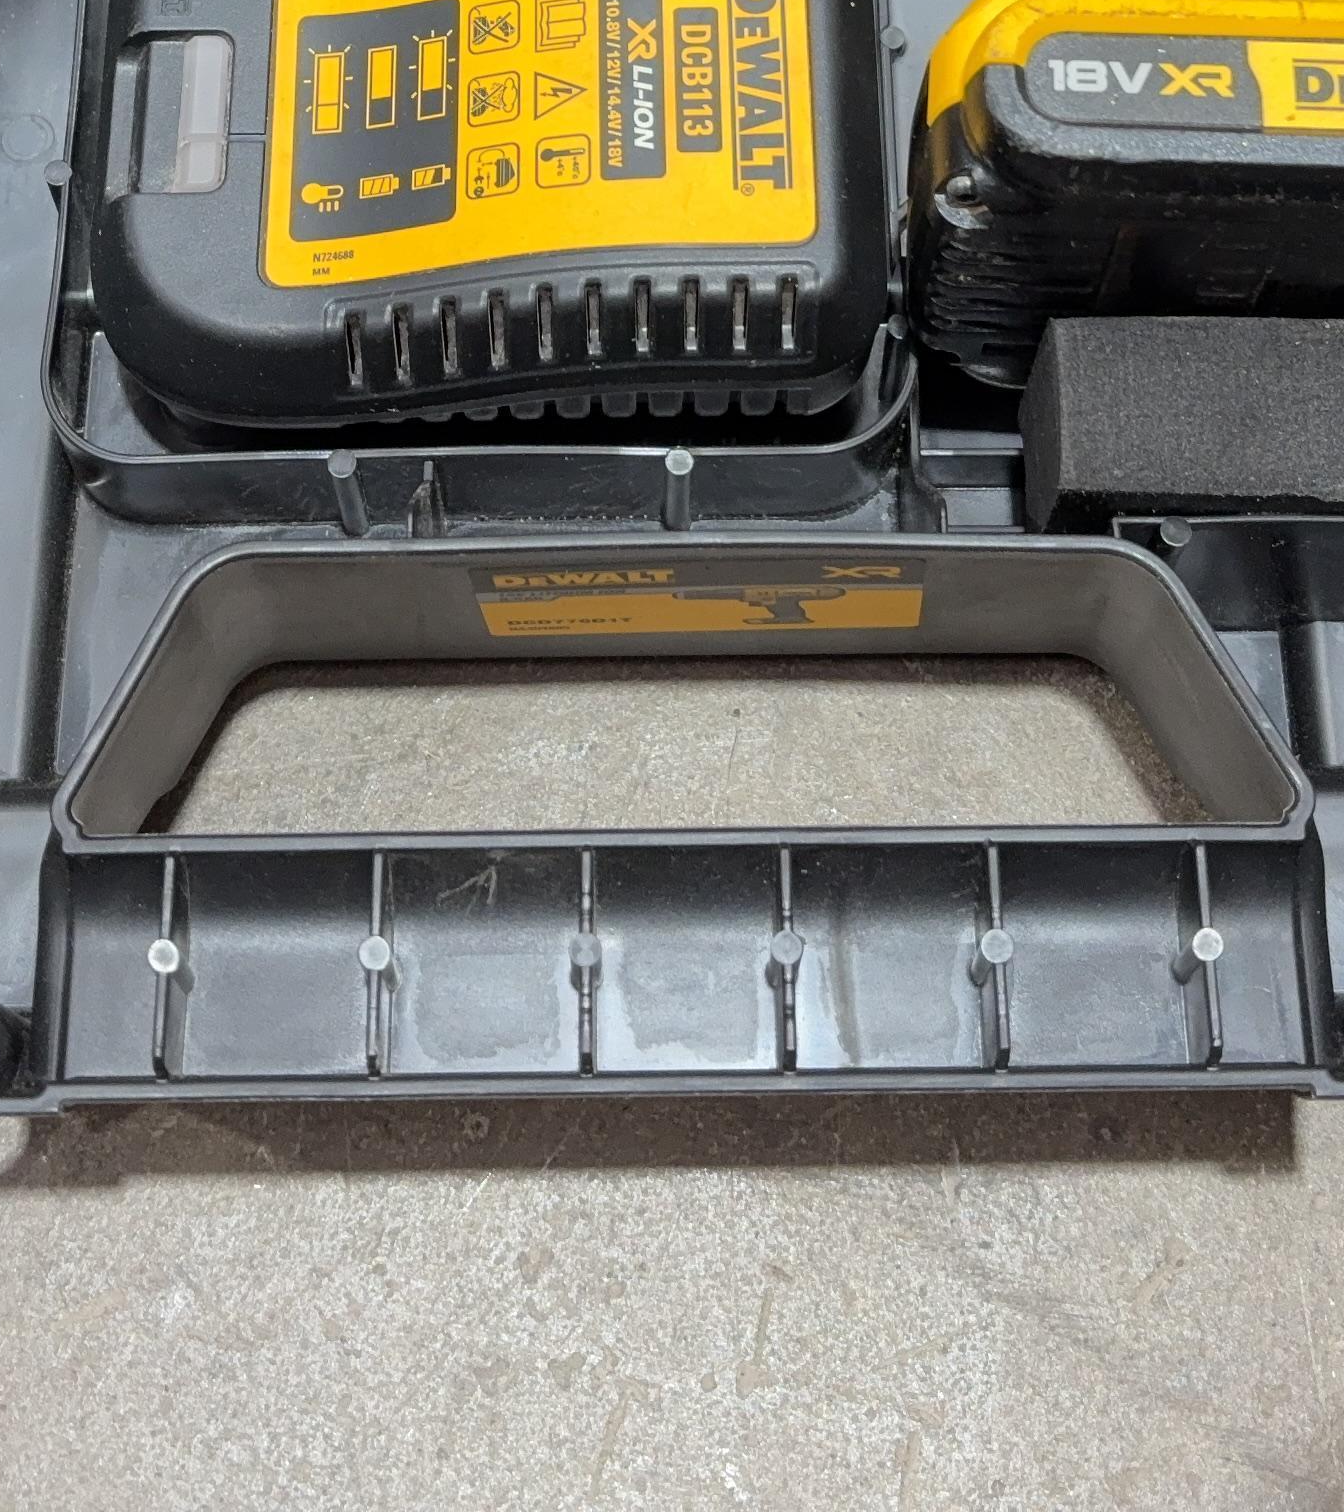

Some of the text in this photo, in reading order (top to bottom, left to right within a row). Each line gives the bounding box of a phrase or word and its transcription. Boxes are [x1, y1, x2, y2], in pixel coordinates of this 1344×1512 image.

[632, 66, 655, 150] LI-ION
[680, 24, 714, 138] DCB113
[1047, 58, 1157, 98] 18V
